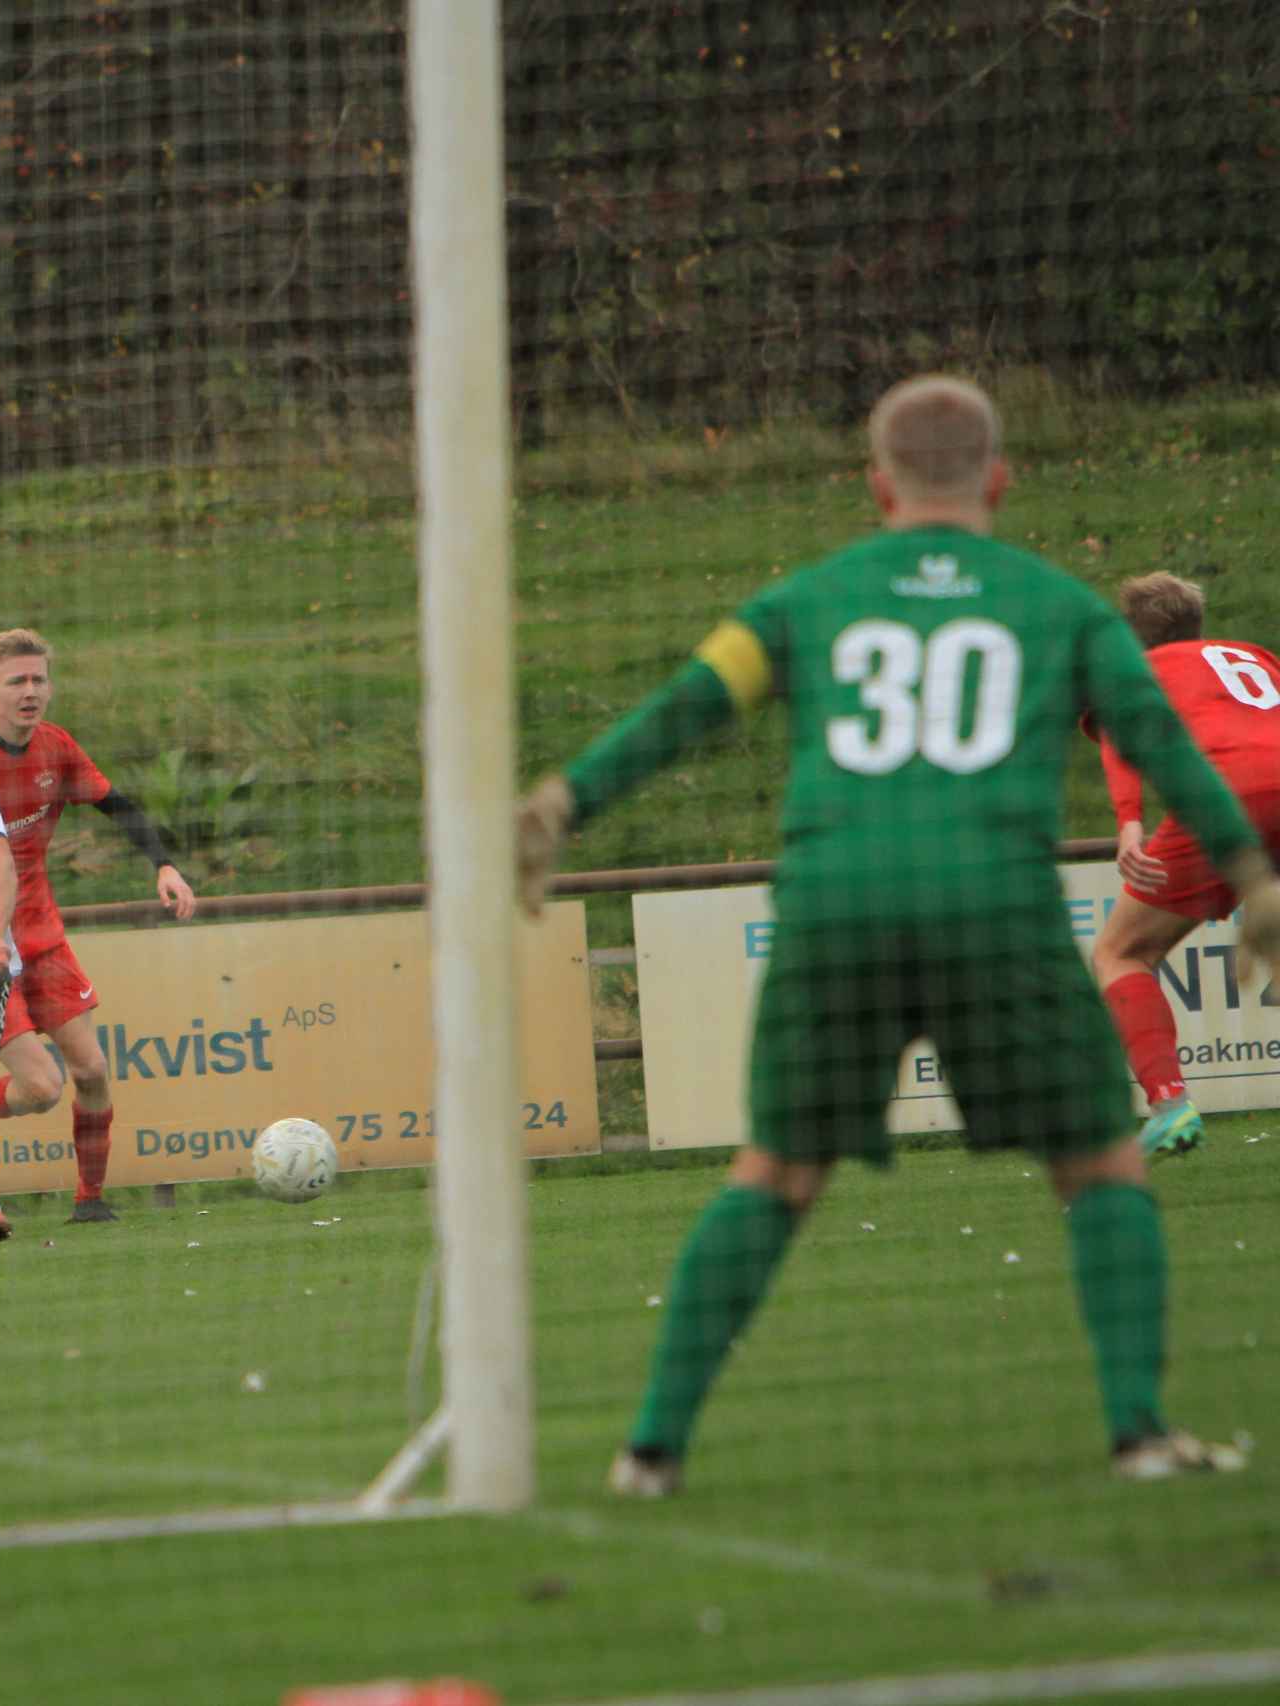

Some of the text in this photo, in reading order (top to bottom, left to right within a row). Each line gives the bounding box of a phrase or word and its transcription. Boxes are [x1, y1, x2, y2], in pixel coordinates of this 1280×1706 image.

[826, 617, 1022, 776] 30
[1201, 645, 1280, 710] 6
[282, 1002, 337, 1029] ApS
[1177, 1037, 1280, 1065] oakme
[136, 1117, 318, 1160] Døgnv
[336, 1113, 382, 1142] 75
[521, 1101, 568, 1130] 24
